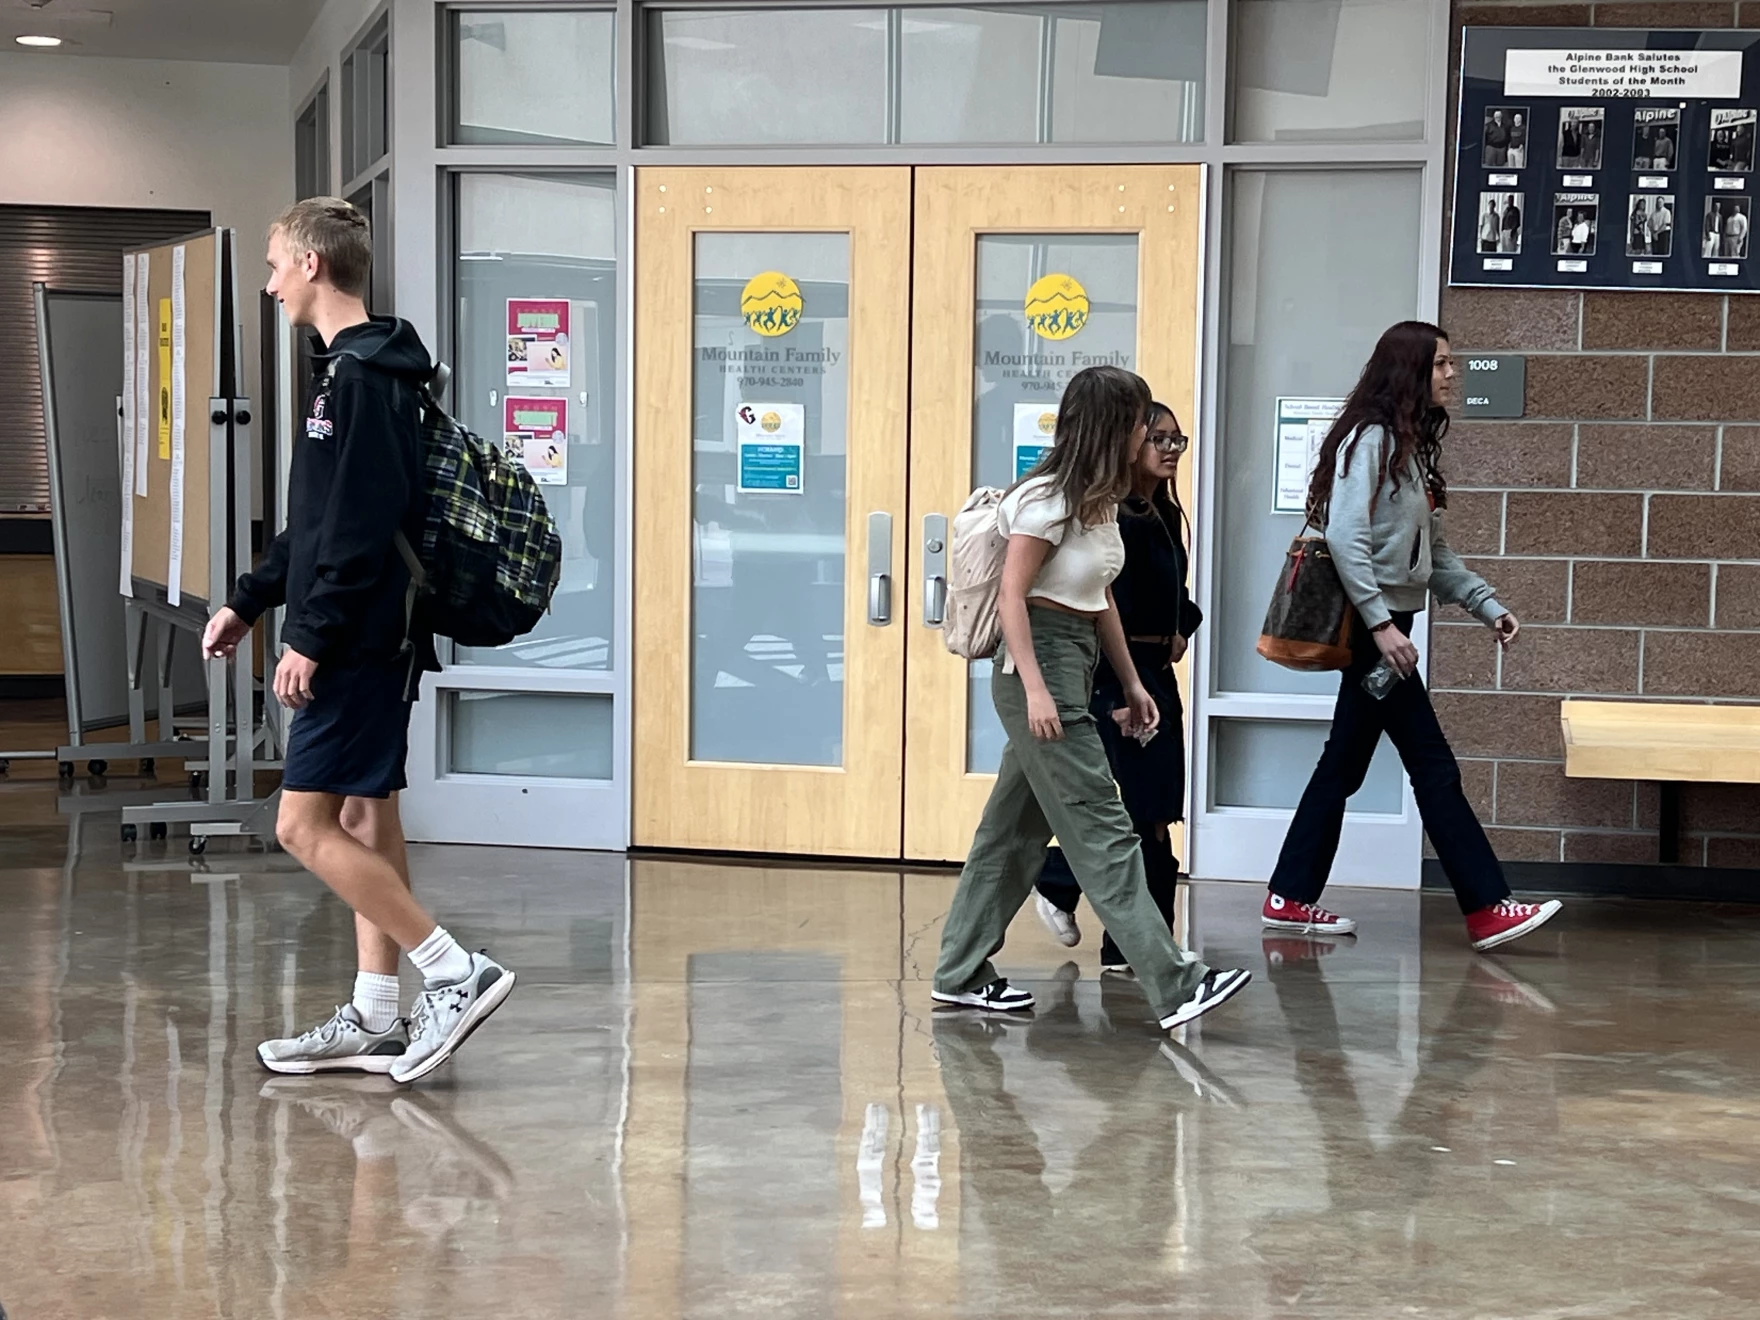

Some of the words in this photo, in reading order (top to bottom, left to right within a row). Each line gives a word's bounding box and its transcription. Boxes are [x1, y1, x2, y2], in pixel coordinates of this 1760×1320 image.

[1566, 53, 1601, 64] Alpine
[1605, 53, 1634, 62] Bank
[1638, 53, 1681, 62] Salutes
[1548, 65, 1566, 73] the
[1569, 65, 1625, 73] Glenwood
[1629, 65, 1656, 75] High
[1659, 65, 1698, 73] School
[1558, 77, 1609, 85] Students
[1613, 77, 1624, 85] of
[1628, 77, 1646, 85] the
[1650, 77, 1686, 86] Month
[1591, 88, 1651, 97] 2002-2003
[1634, 109, 1676, 122] Alpine
[701, 347, 780, 361] Mountain
[785, 347, 841, 366] Family
[984, 350, 1065, 366] Mountain
[1072, 350, 1130, 368] Family
[719, 365, 766, 374] HEALTH
[771, 365, 827, 374] CENTERS
[1468, 359, 1498, 371] 1008
[1002, 369, 1050, 378] HEALTH
[737, 377, 804, 389] 970-945-2840
[1021, 381, 1068, 391] 970-945-
[1466, 397, 1490, 405] DECA
